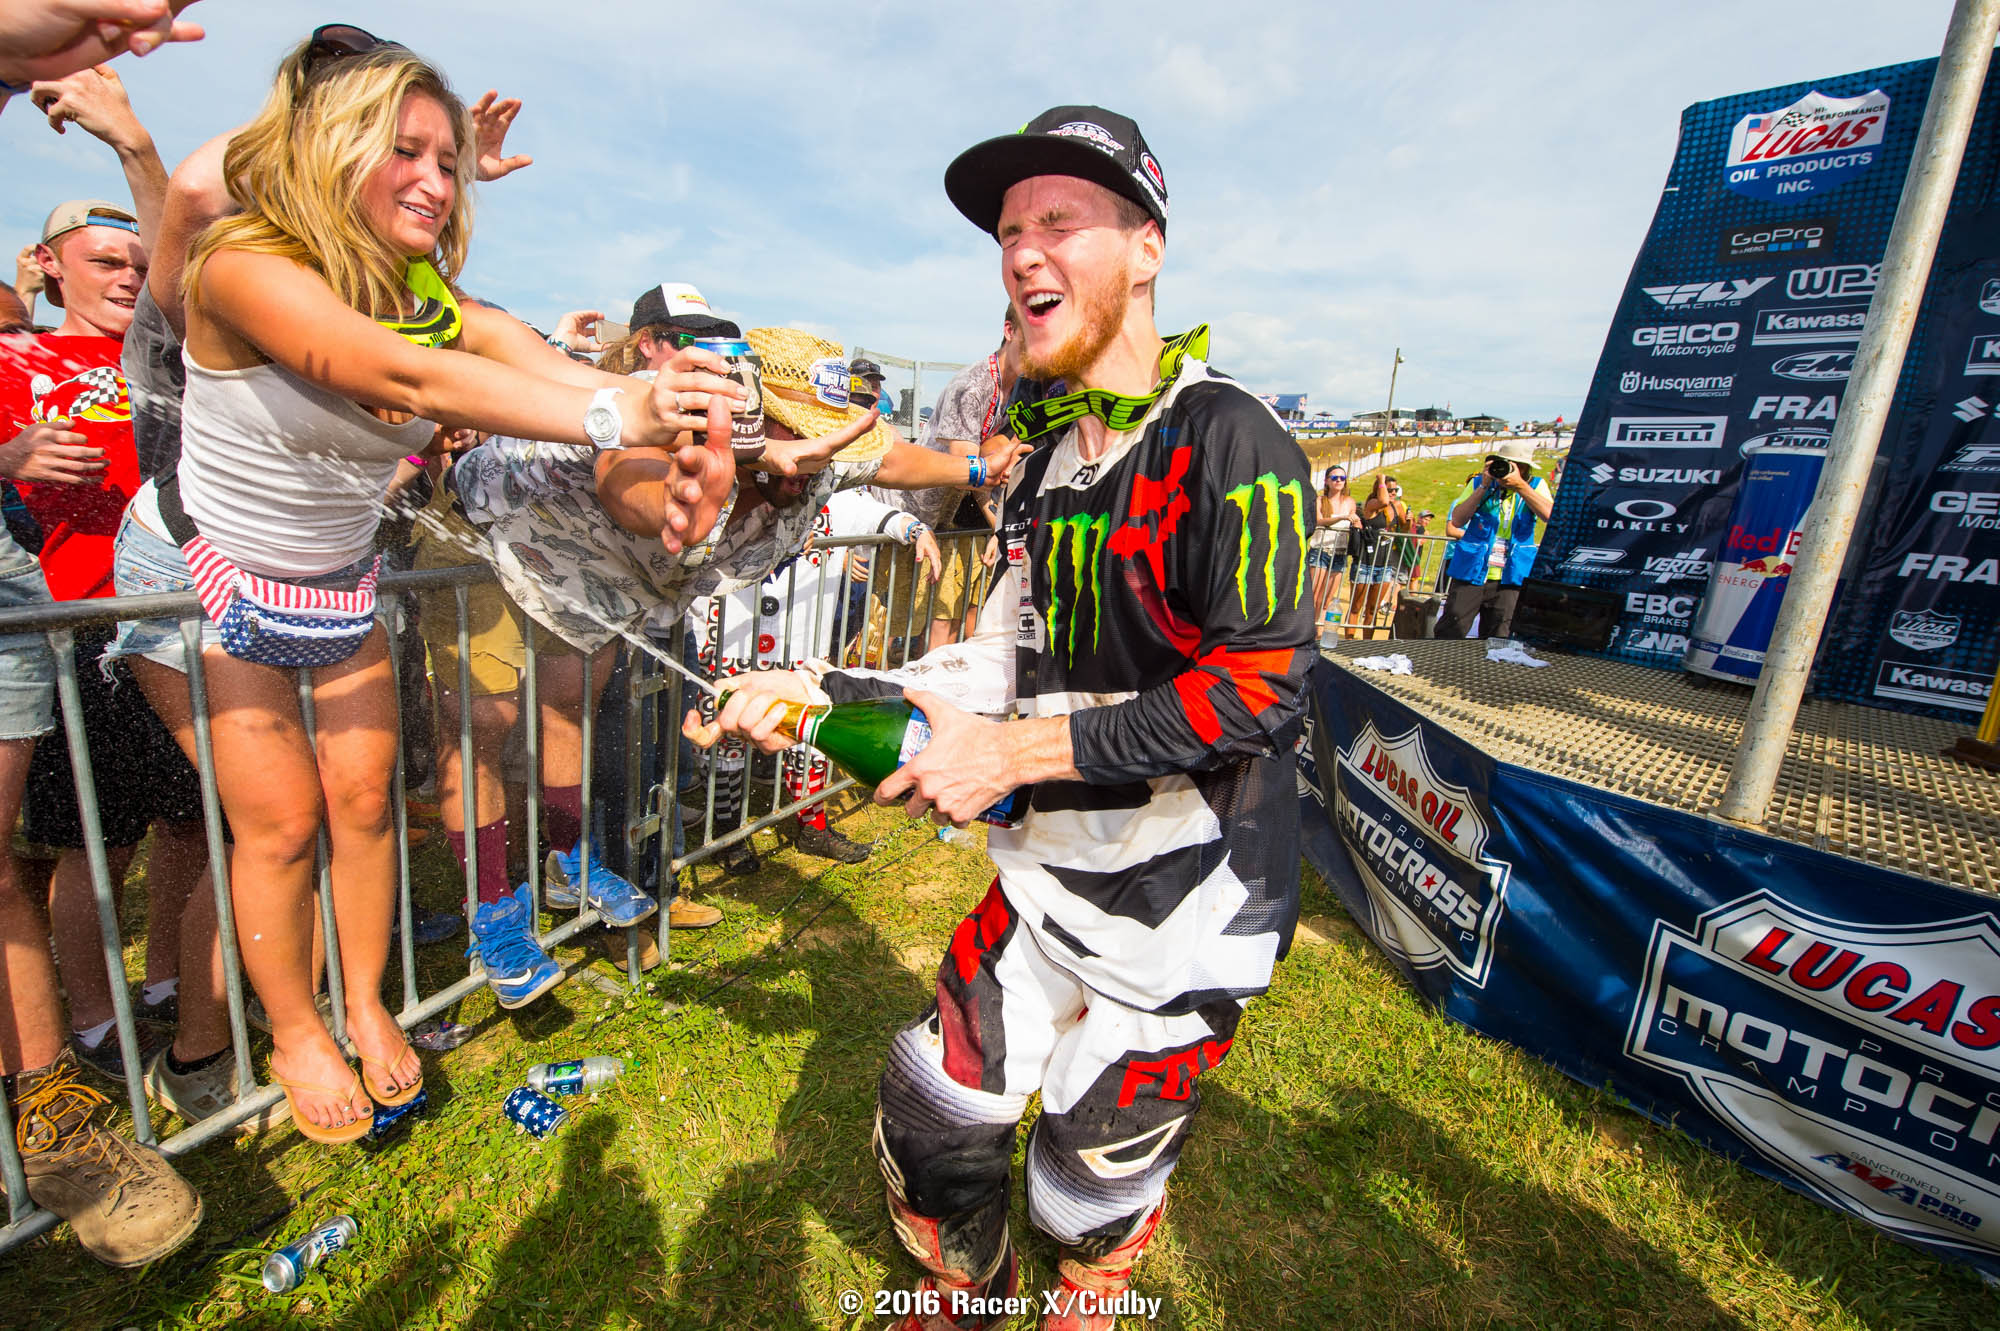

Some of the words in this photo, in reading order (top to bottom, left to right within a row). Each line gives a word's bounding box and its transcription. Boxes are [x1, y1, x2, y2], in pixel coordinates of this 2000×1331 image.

[1813, 104, 1887, 122] PERFORMANCE
[1740, 115, 1881, 163] LUCAS
[1729, 168, 1760, 184] OIL
[1766, 151, 1873, 179] PRODUCTS
[1776, 179, 1815, 195] INC.
[1730, 226, 1825, 247] GoPro
[1641, 276, 1777, 305] FLY
[1663, 300, 1743, 312] RACING
[1631, 321, 1741, 347] GEICO
[1651, 341, 1737, 358] Motorcycle
[1640, 374, 1735, 393] Husqvarna
[1748, 395, 1838, 421] FRA
[1616, 422, 1717, 442] PIRELLI
[1618, 467, 1722, 485] SUZUKI
[1596, 518, 1689, 534] OAKLEY
[1727, 524, 1783, 553] Red
[1717, 574, 1768, 591] ENERGY
[1625, 592, 1695, 620] EBC
[1642, 614, 1690, 629] BRAKES
[1898, 620, 1957, 636] LUCAS
[1359, 742, 1419, 812] LUCAS
[1420, 790, 1464, 846] OIL
[1382, 812, 1426, 850] PRO
[1336, 788, 1483, 931] MOTOCROSS
[1739, 925, 2000, 1052] LUCAS
[1850, 1151, 1941, 1195] SANCTIONED
[1944, 1191, 1968, 1205] BY
[1918, 1193, 1983, 1228] PRO
